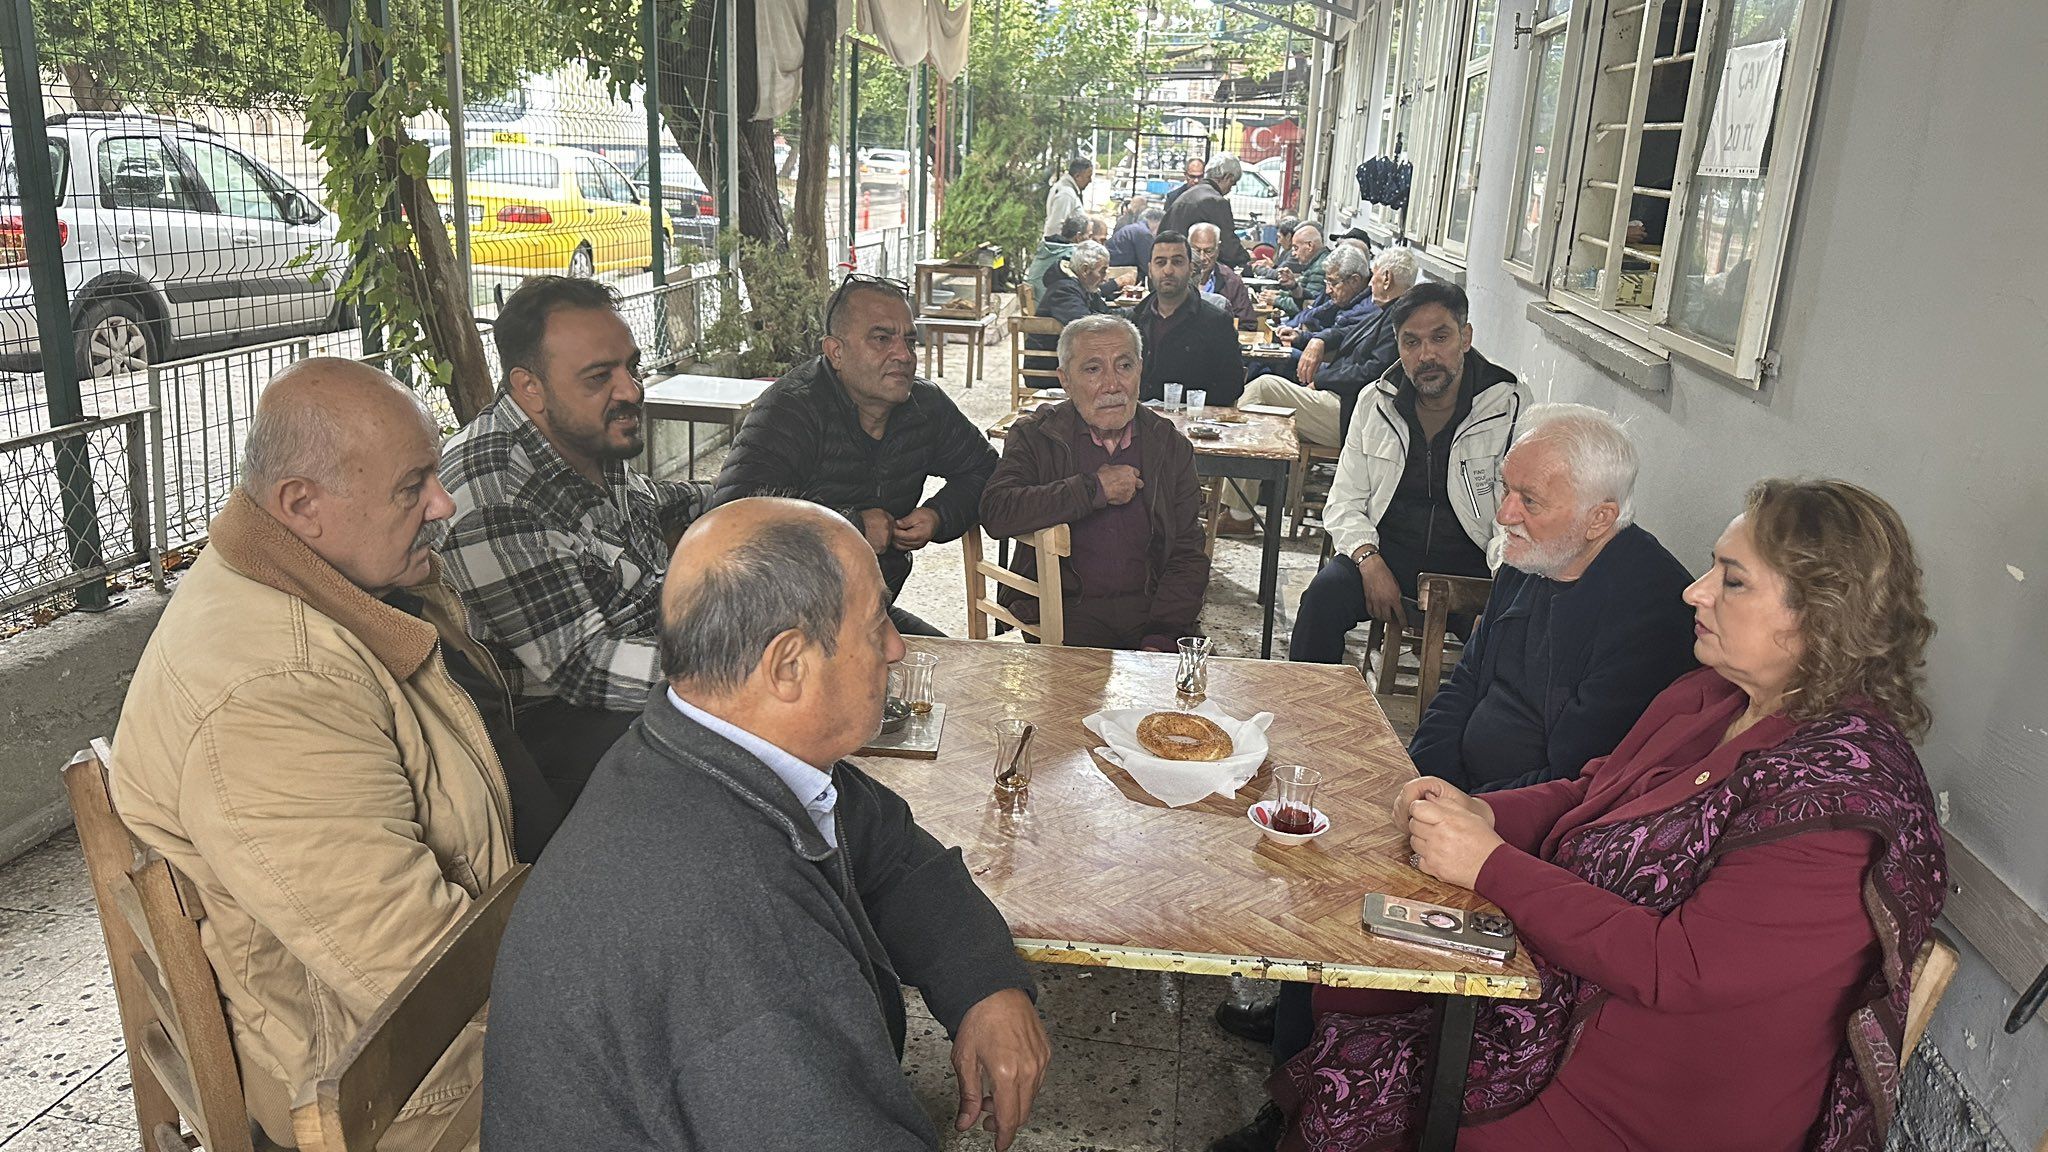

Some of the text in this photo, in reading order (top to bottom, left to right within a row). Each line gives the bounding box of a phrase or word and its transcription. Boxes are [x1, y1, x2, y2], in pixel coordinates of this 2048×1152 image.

[1738, 60, 1765, 98] ÇAY
[1723, 122, 1754, 152] 20 TL
